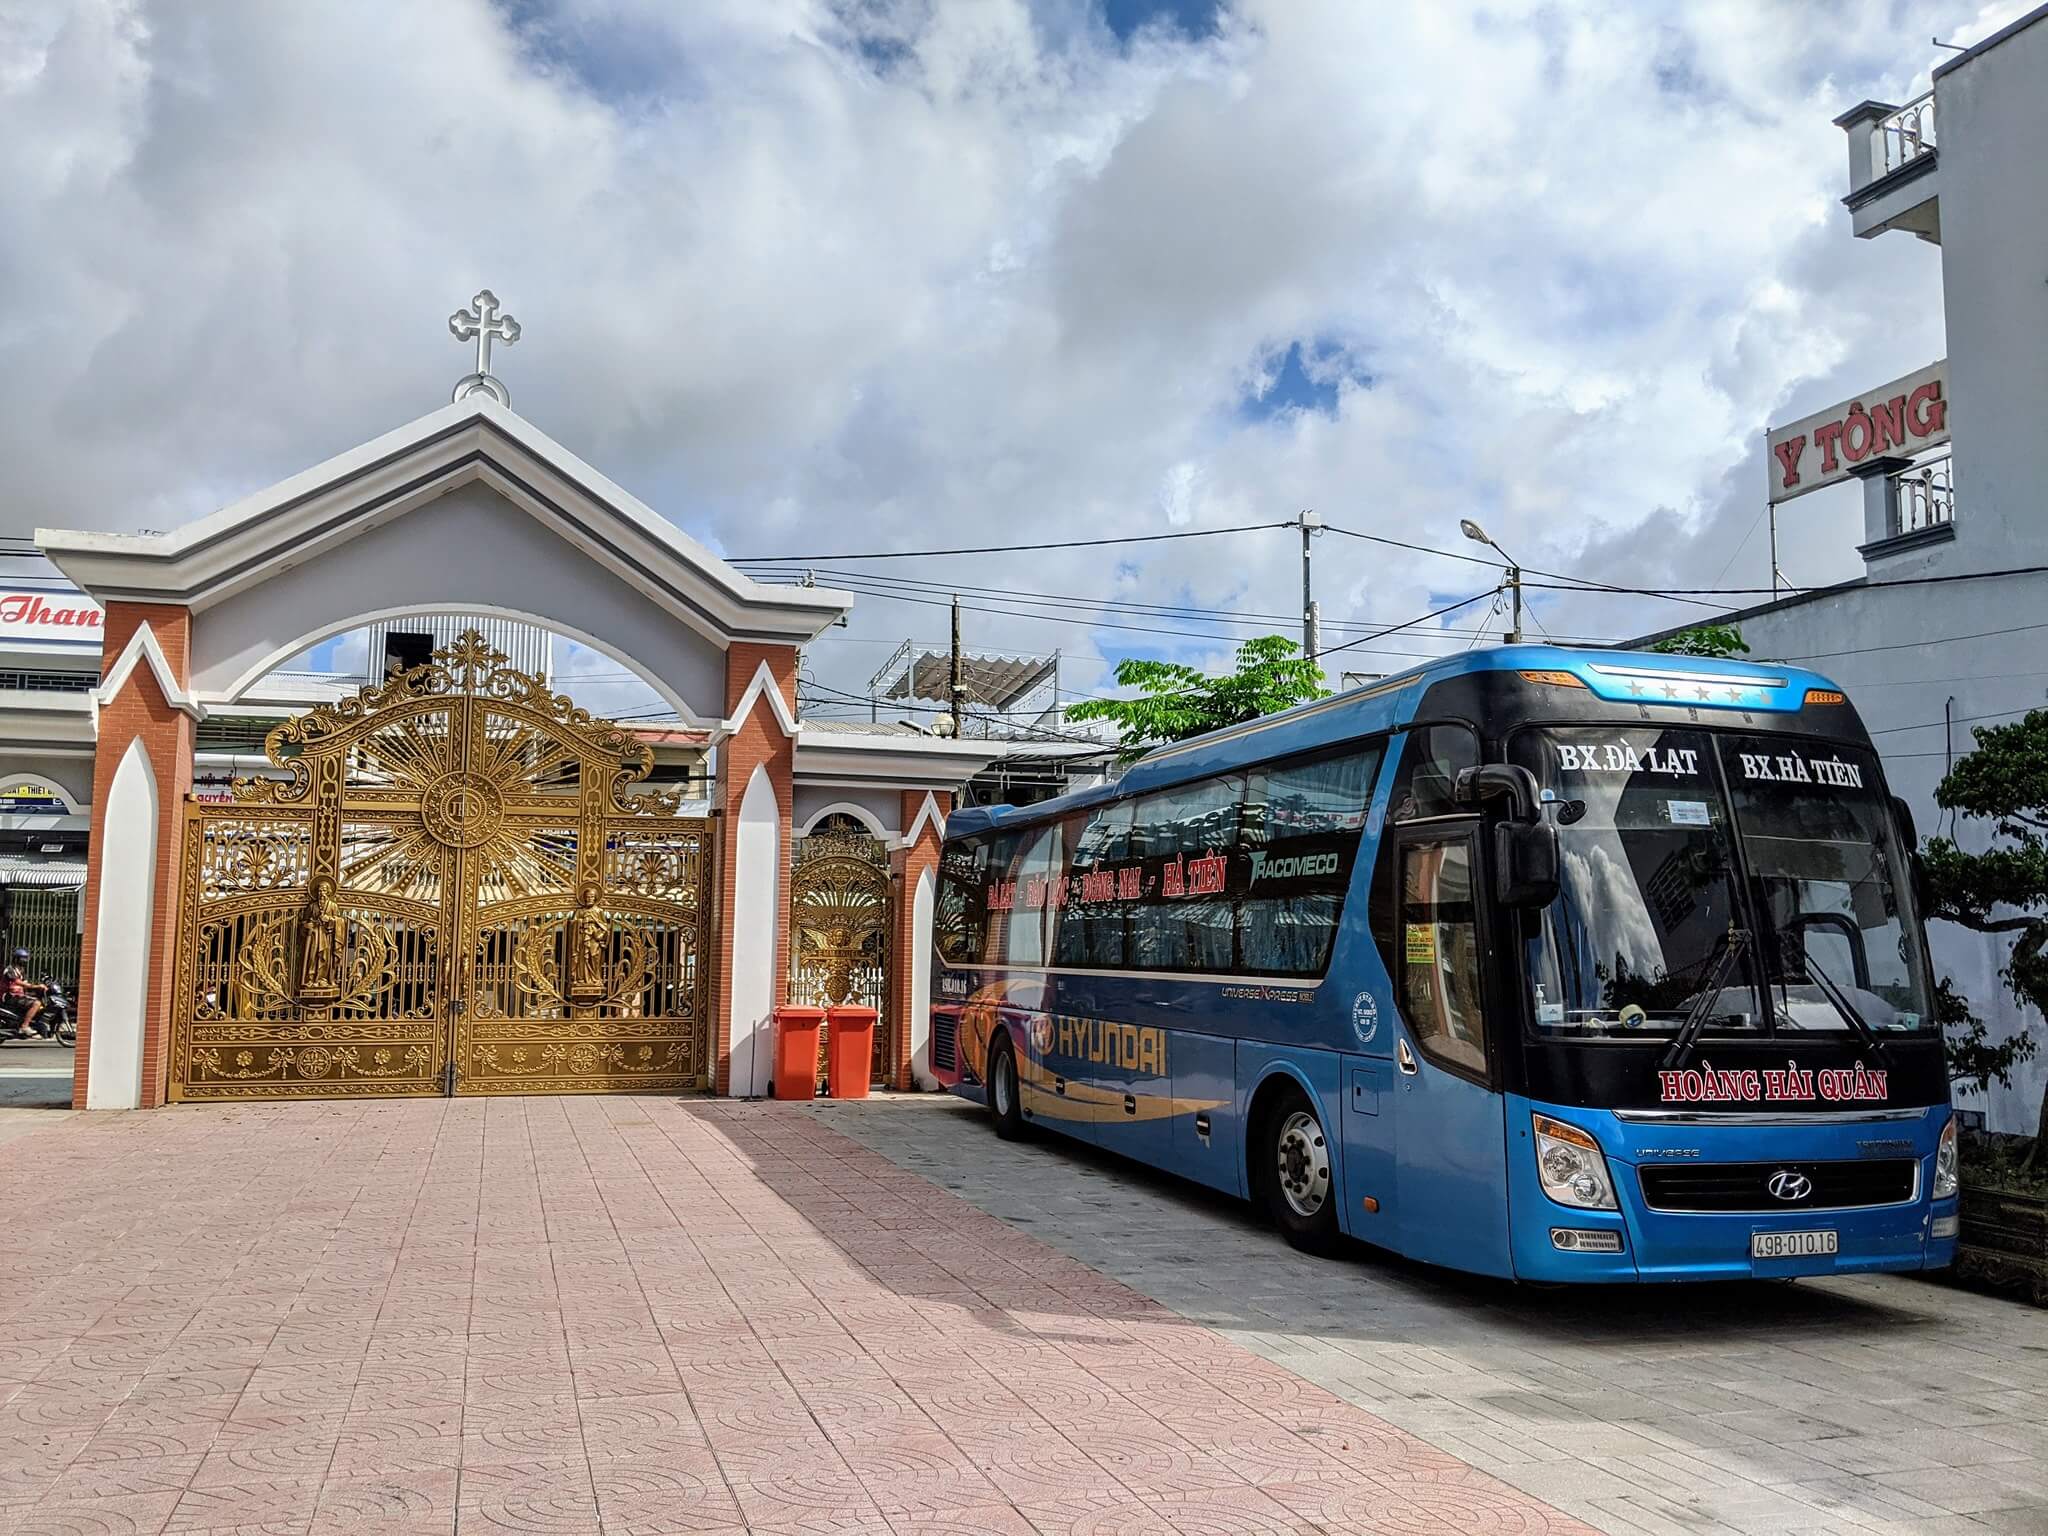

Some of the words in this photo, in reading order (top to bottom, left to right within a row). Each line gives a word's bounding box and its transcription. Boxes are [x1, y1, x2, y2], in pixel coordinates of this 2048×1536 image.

[1775, 435, 1806, 488] Y
[1814, 380, 1947, 474] TÔNG
[0, 596, 104, 627] Than
[1557, 738, 1644, 772] BX.ĐÀ
[1646, 748, 1698, 779] LẠT
[1740, 750, 1812, 783] BX.HÀ
[1810, 754, 1863, 788] TIÊN
[1117, 867, 1141, 900] NAI
[1162, 852, 1185, 896] HÀ
[1188, 848, 1227, 895] TIÊN
[1248, 851, 1338, 891] TRACOMECO
[1058, 1017, 1166, 1077] HYUNDAI
[1658, 1060, 1761, 1101] HOÀNG
[1763, 1060, 1816, 1100] HẢI
[1818, 1060, 1888, 1101] QUÂN
